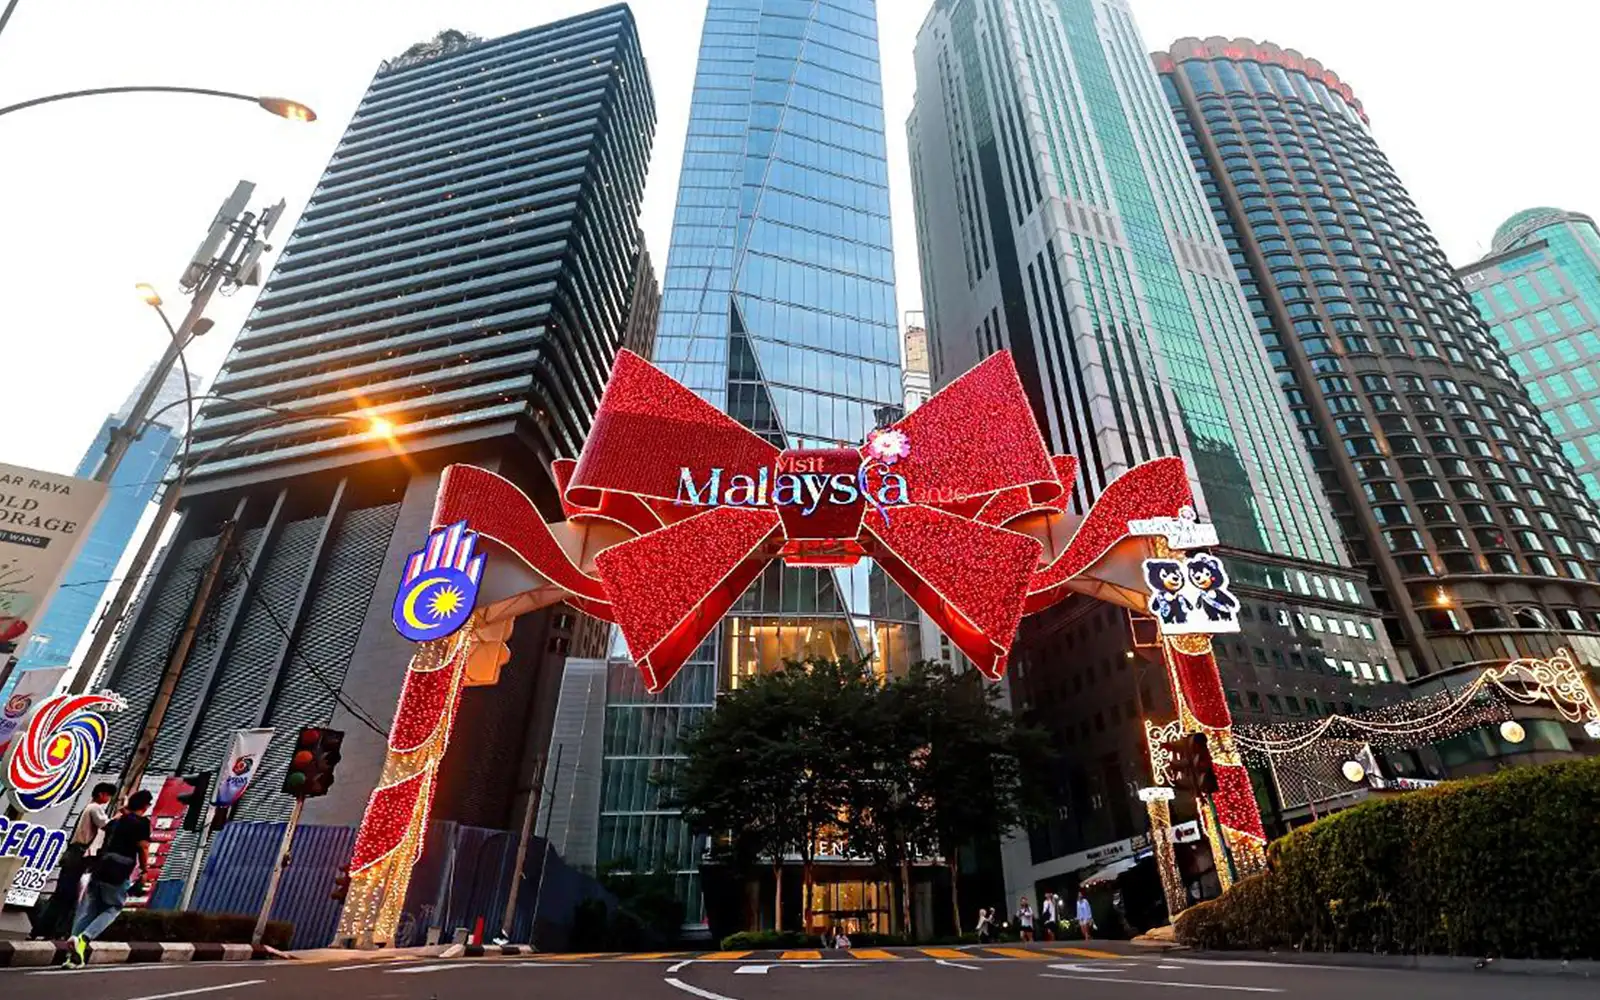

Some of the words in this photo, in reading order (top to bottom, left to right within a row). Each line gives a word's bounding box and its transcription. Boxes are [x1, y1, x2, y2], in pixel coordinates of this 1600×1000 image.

[774, 455, 825, 473] Visit
[28, 479, 71, 496] RAYA
[673, 460, 910, 521] Malaysia
[10, 533, 41, 545] WANG
[13, 869, 46, 889] 2025
